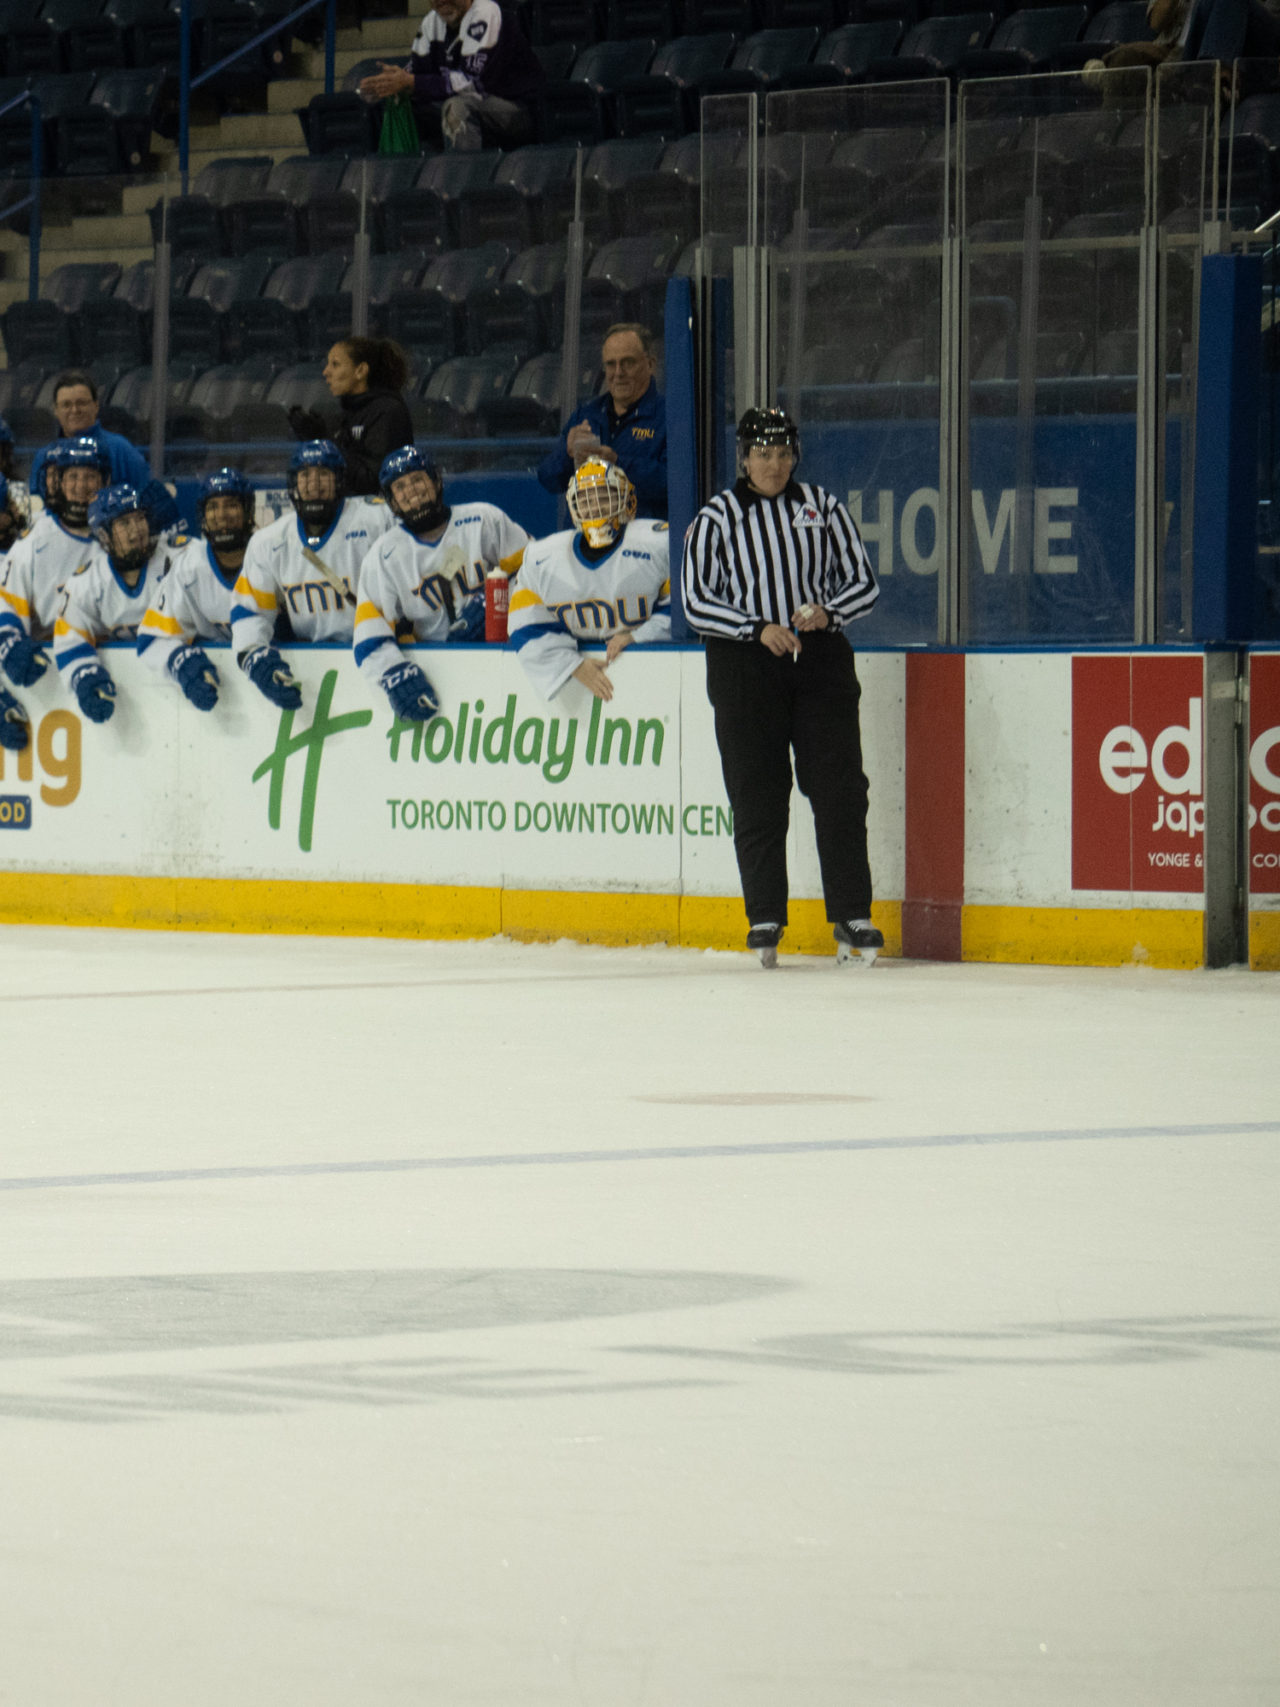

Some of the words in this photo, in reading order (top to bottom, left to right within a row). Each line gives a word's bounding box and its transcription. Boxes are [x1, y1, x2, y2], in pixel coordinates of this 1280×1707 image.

[847, 487, 1079, 576] HOME
[386, 693, 579, 784] Holiday
[585, 696, 665, 767] Inn
[387, 799, 506, 831] TORONTO
[514, 801, 674, 836] DOWNTOWN
[683, 804, 733, 837] CEN
[1148, 852, 1189, 868] YONGE
